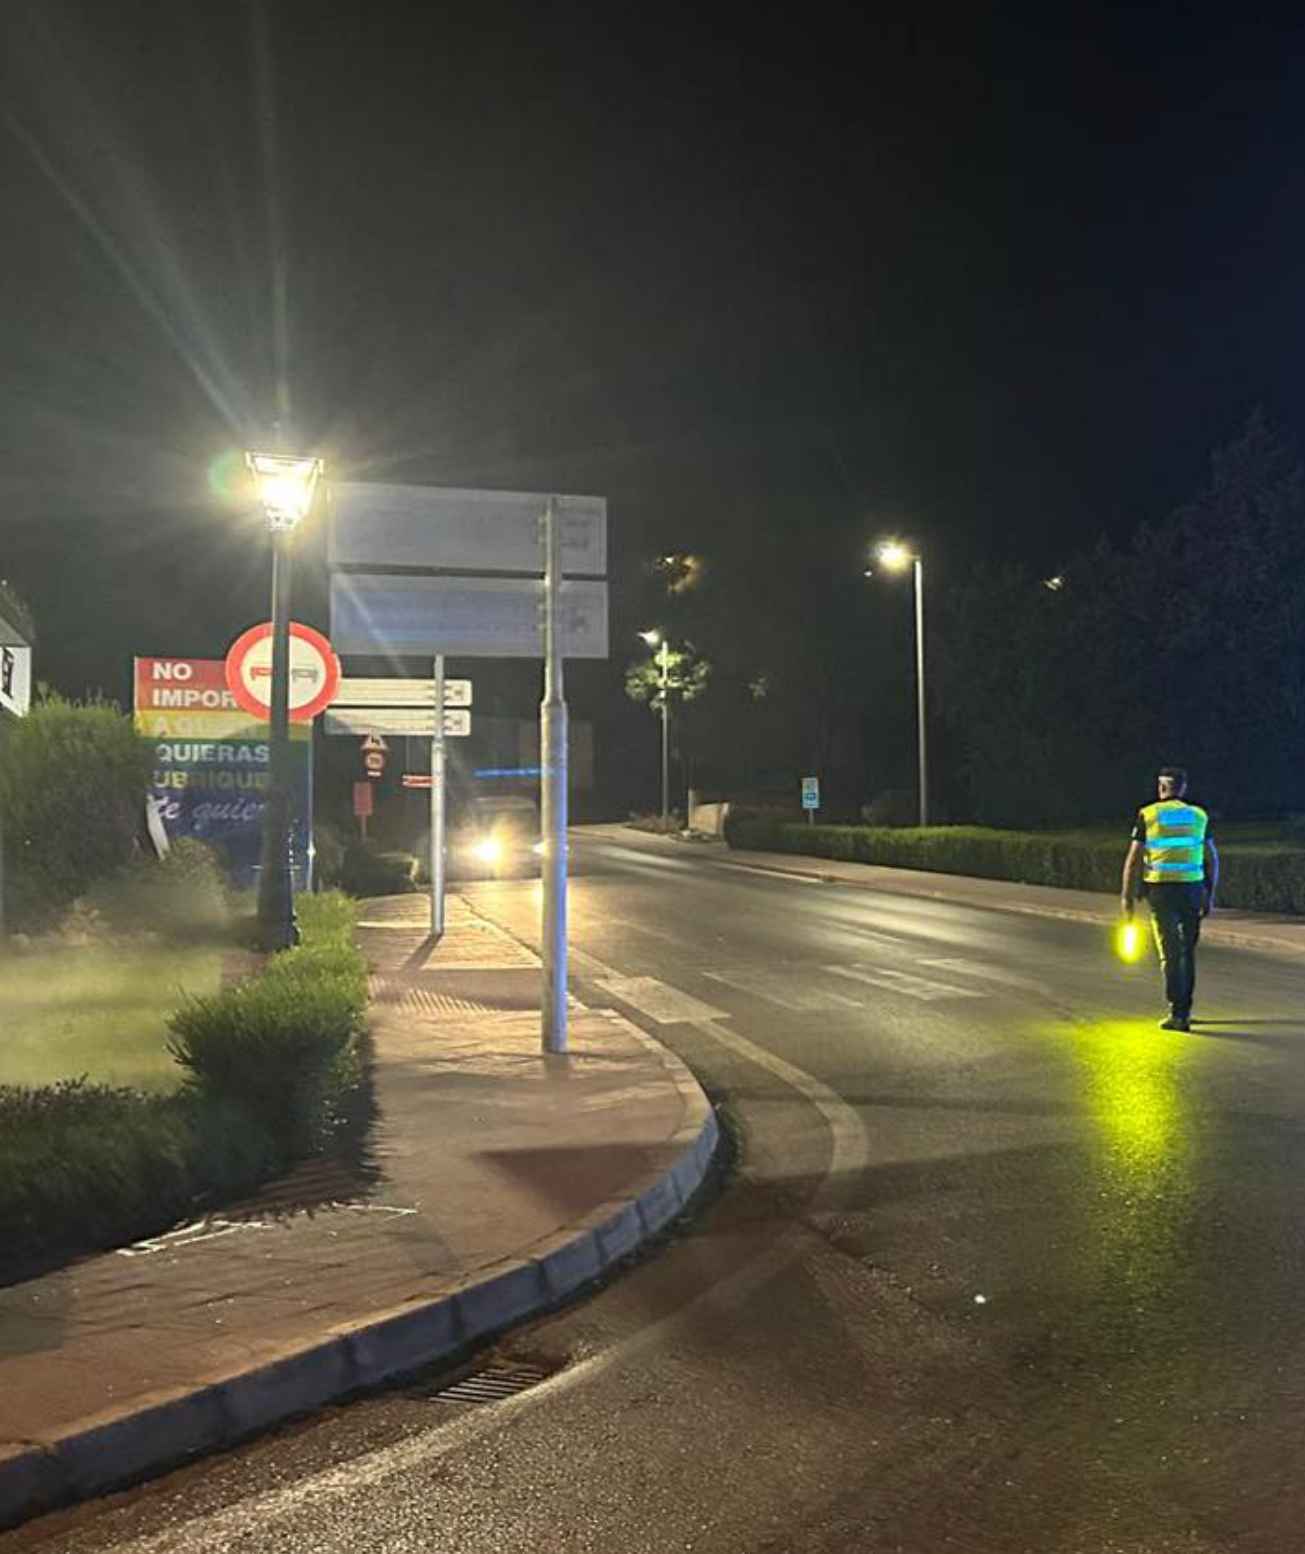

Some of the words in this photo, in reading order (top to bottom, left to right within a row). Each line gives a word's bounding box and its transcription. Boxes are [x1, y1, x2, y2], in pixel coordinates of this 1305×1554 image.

[152, 662, 193, 680] NO
[152, 689, 237, 708] IMPOR
[156, 744, 270, 763] QUIERAS
